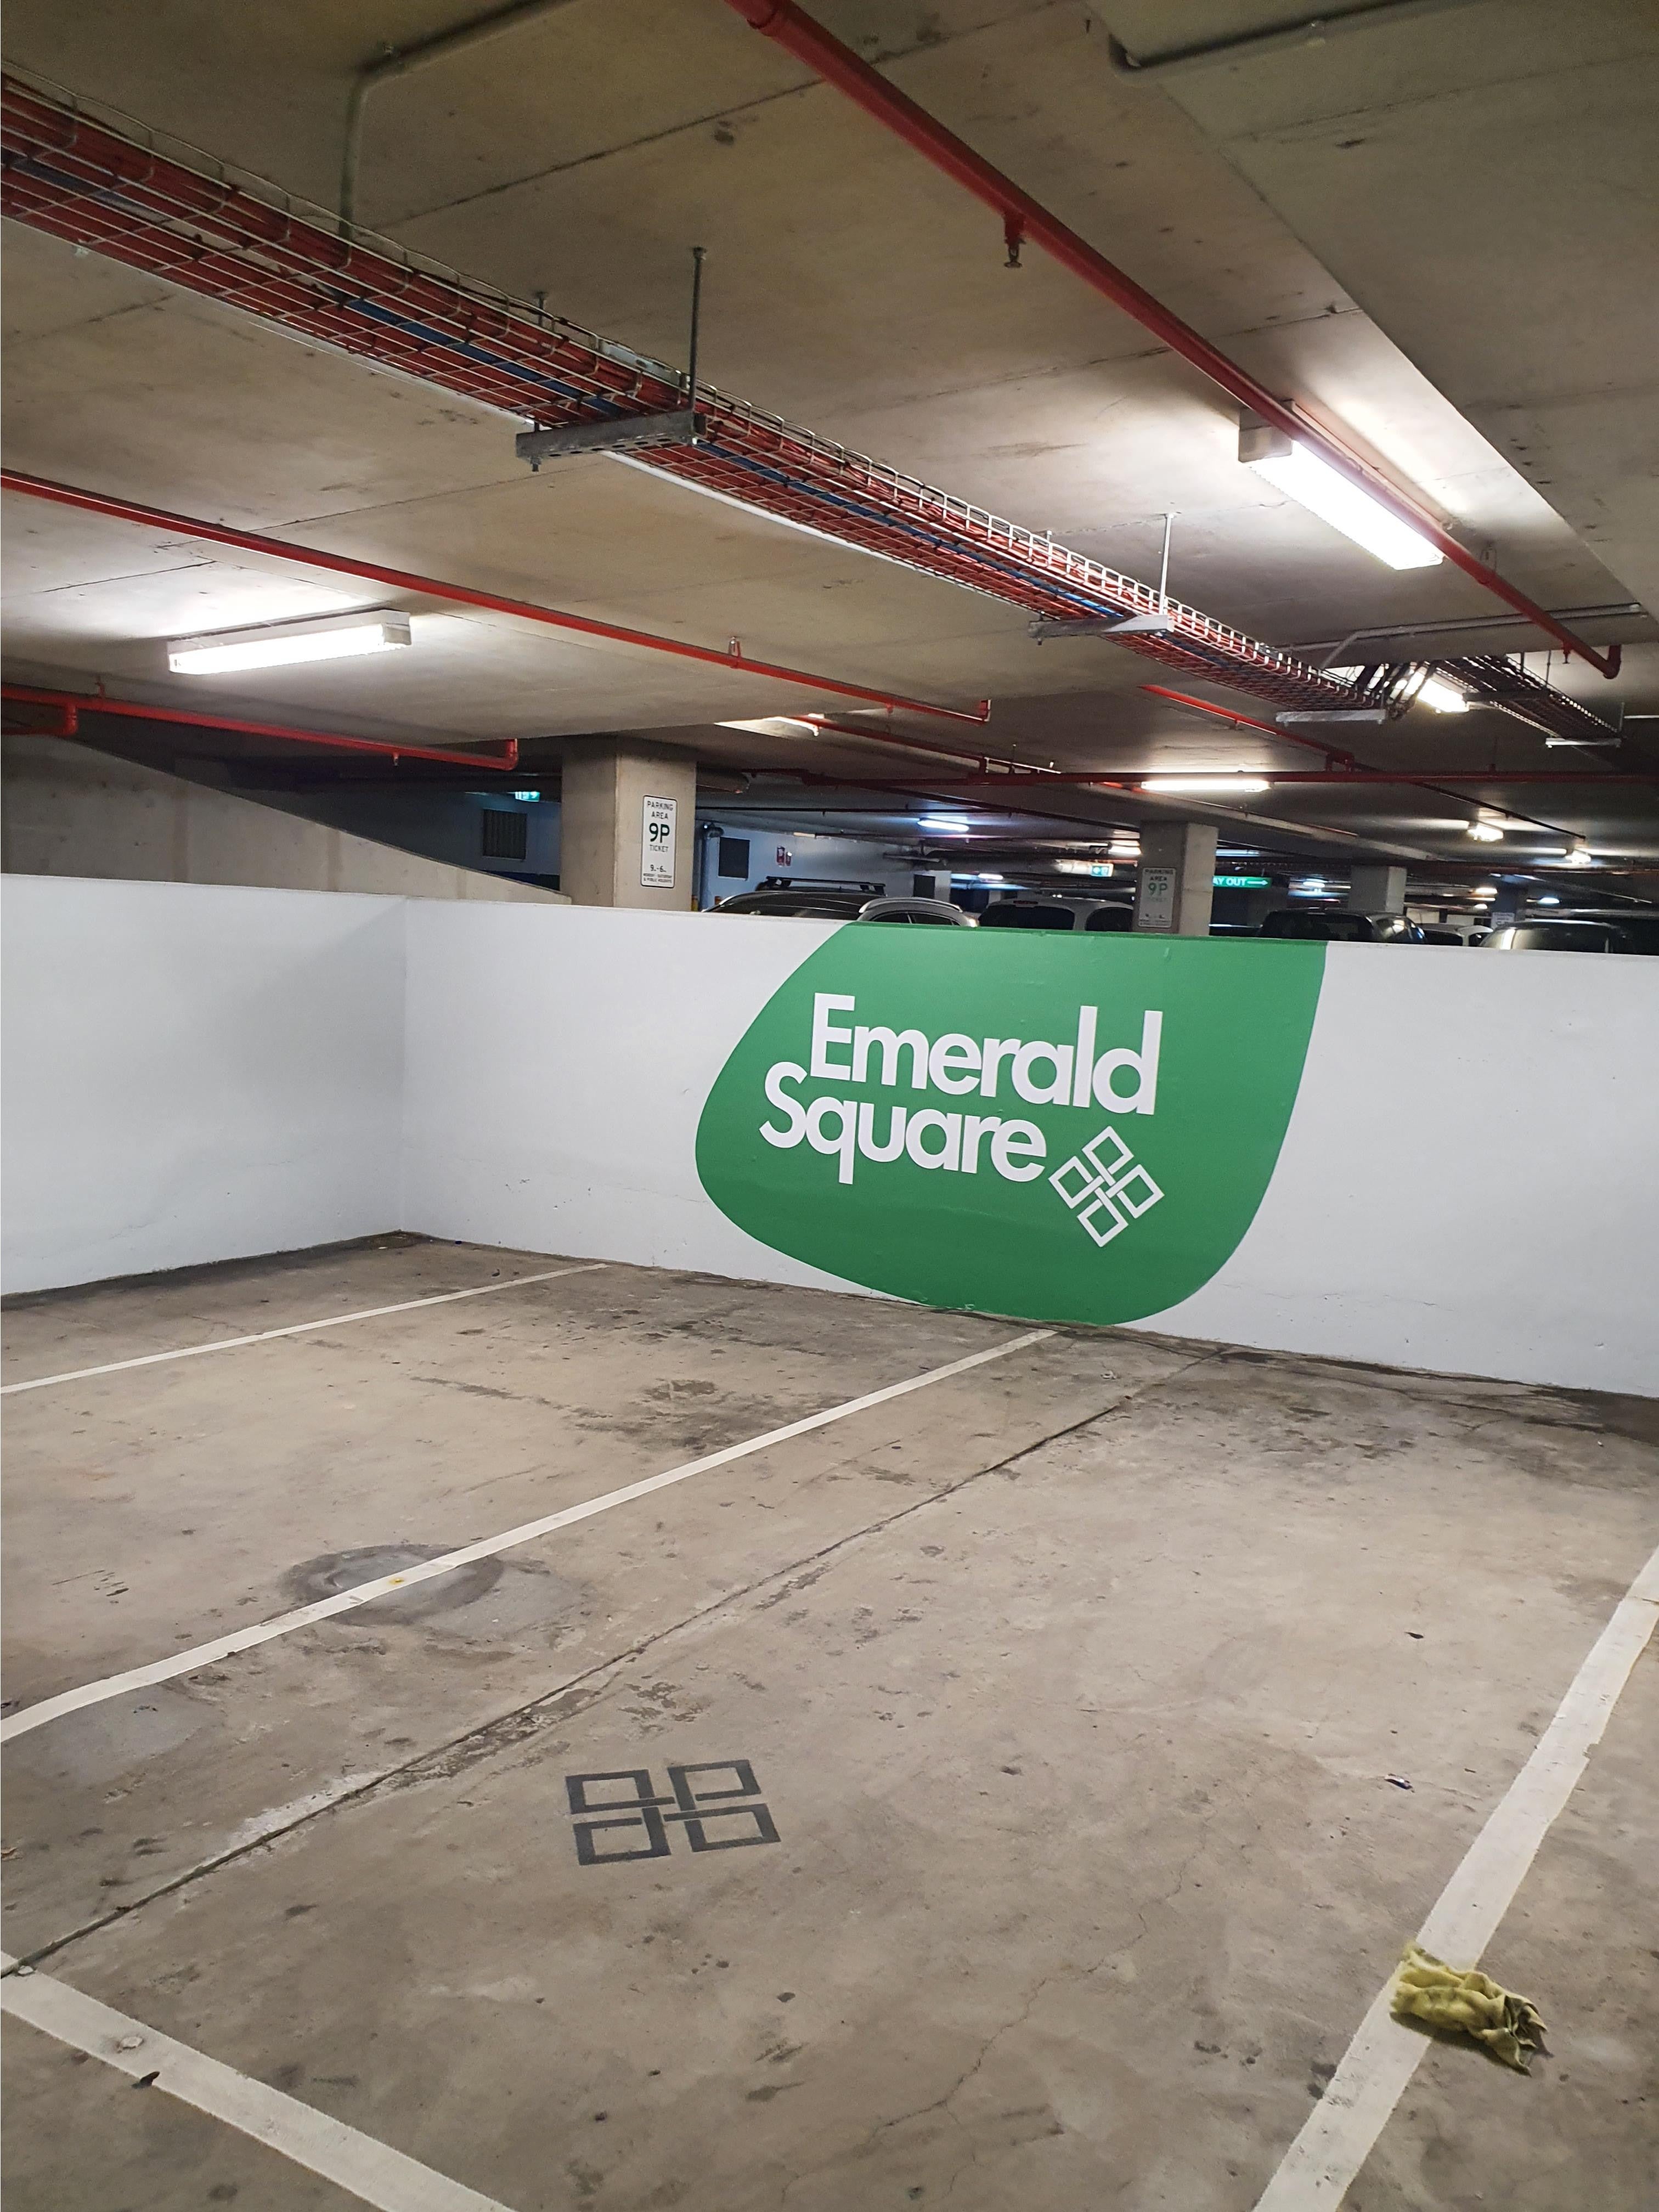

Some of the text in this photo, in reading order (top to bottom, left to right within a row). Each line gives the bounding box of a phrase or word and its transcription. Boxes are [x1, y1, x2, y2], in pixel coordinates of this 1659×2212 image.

[647, 800, 674, 811] PARKING
[651, 811, 669, 820] AREA
[649, 822, 670, 843] 9P
[649, 844, 669, 853] TICKET
[1212, 877, 1247, 887] AY OUT
[1148, 882, 1168, 896] 9P
[810, 992, 1163, 1115] Emerald
[759, 1062, 1047, 1185] Square
